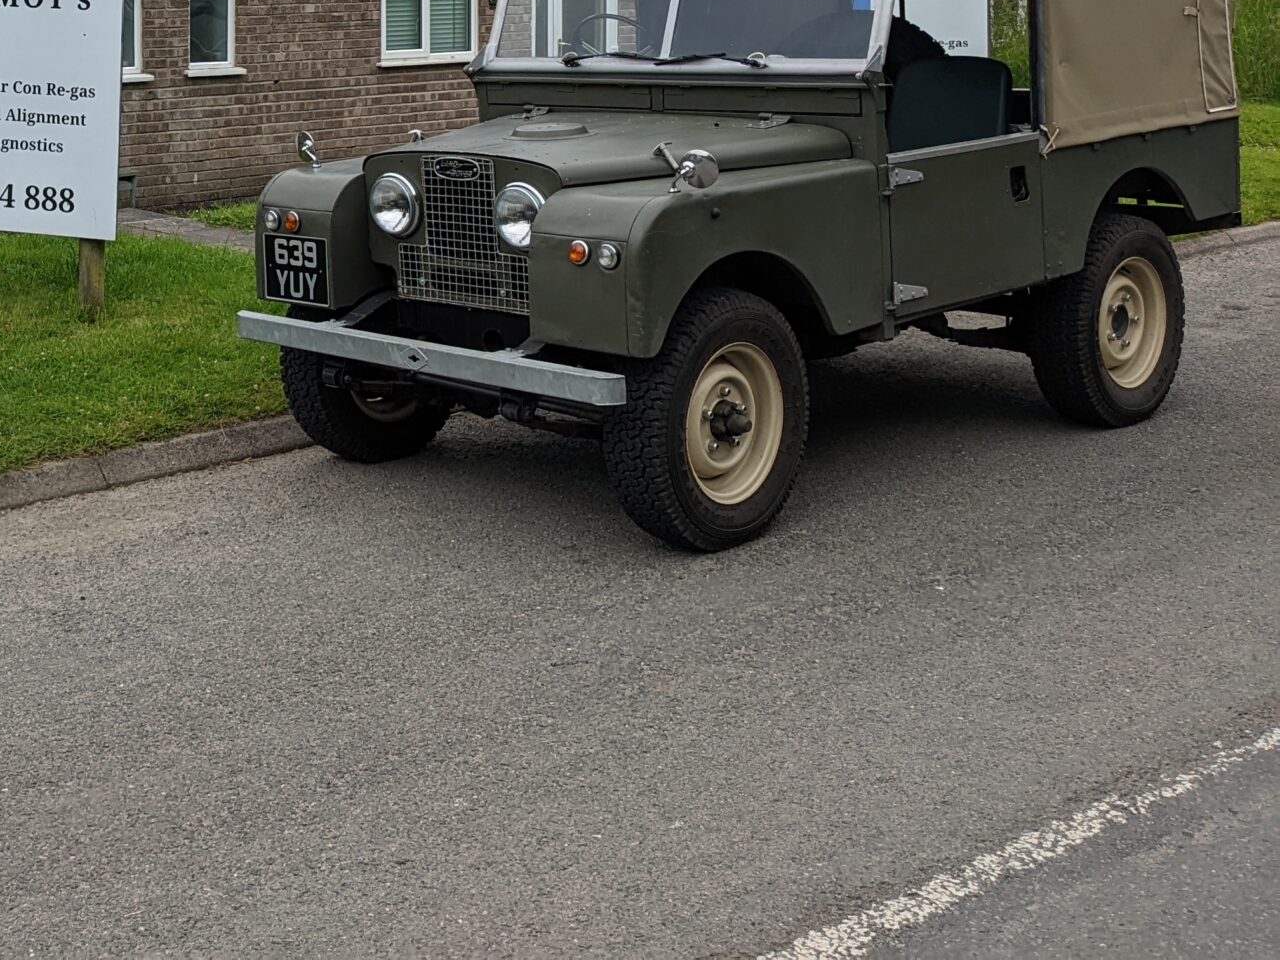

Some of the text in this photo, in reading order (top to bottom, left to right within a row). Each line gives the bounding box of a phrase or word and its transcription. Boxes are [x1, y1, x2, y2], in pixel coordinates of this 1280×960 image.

[12, 81, 42, 95] Con
[46, 83, 96, 101] Re-gas
[5, 108, 87, 127] Alignment
[23, 184, 75, 213] 888
[274, 238, 318, 269] 639
[276, 269, 318, 301] YUY
